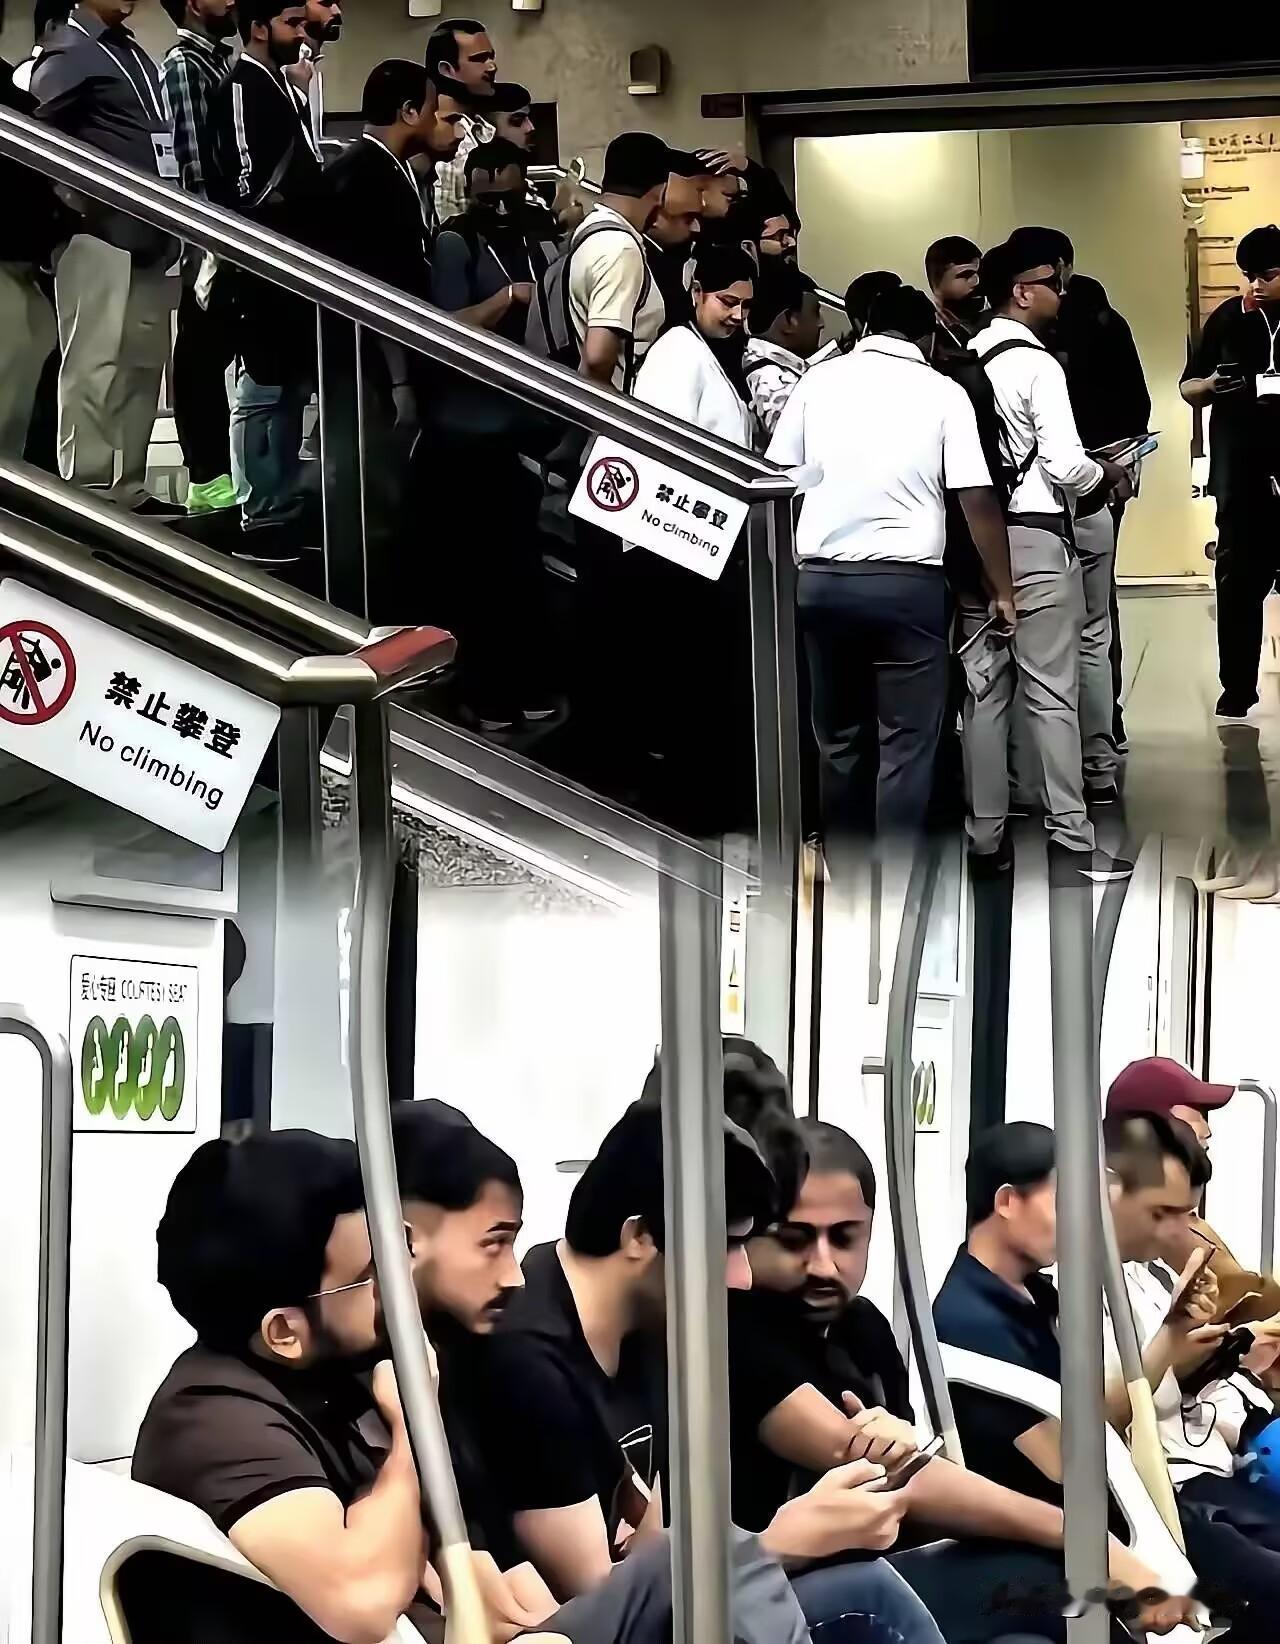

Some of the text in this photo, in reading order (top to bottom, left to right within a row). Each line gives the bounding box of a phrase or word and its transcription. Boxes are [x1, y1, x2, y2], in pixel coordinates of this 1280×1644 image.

[641, 509, 720, 557] No climbing
[104, 671, 241, 759] 禁止攀登
[79, 720, 224, 810] No climbing
